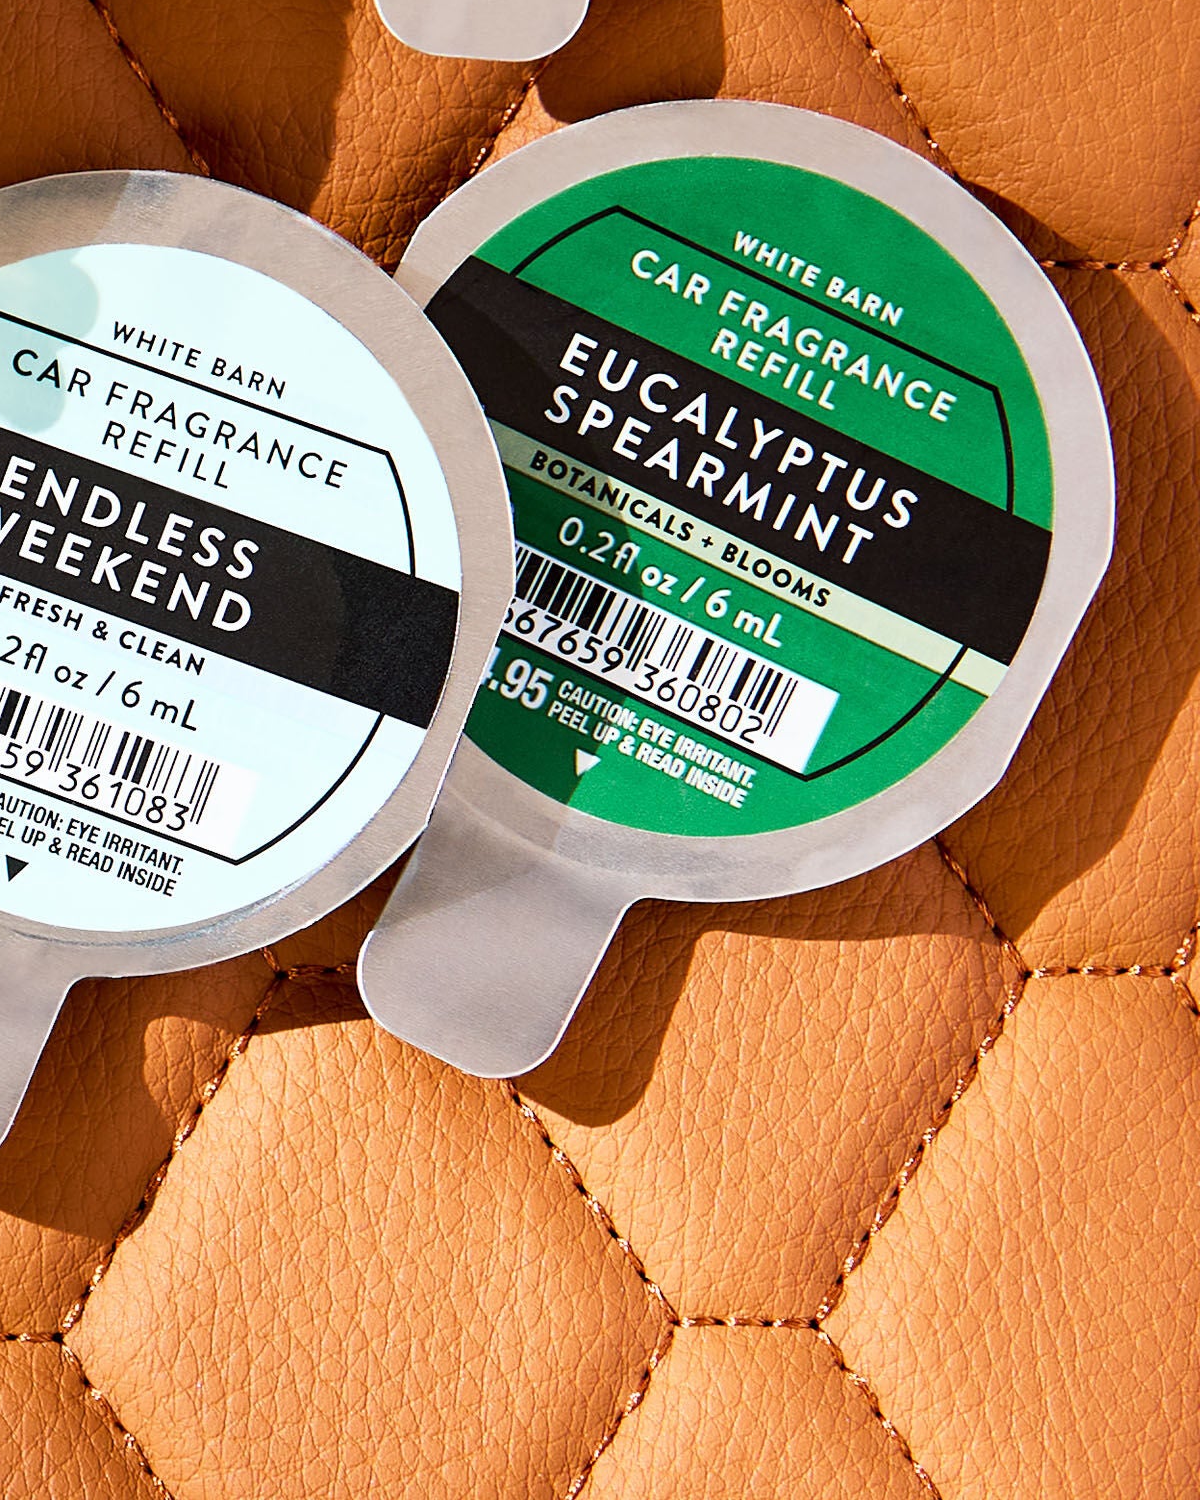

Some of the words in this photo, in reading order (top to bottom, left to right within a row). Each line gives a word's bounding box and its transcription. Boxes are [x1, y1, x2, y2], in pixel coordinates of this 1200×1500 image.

[734, 231, 821, 288] WHITE
[825, 276, 903, 327] BARN
[113, 321, 202, 369] WHITE
[210, 357, 286, 399] BARN
[631, 249, 710, 305] CAR
[718, 290, 957, 422] FRAGRANCE
[710, 328, 835, 411] REFILL
[12, 349, 91, 397] CAR
[105, 381, 348, 489] FRAGRANCE
[101, 420, 228, 489] REFILL
[559, 332, 918, 529] EUCALYPTUS
[544, 385, 874, 564] SPEARMINT
[0, 455, 260, 580] ENDLESS
[528, 449, 694, 541] BOTANICALS
[701, 535, 714, 548] +
[720, 542, 831, 607] BLOOMS
[92, 620, 109, 641] &
[119, 630, 206, 676] CLEAN
[641, 566, 678, 596] oz
[680, 576, 706, 603] /
[705, 589, 731, 618] 6
[732, 610, 782, 648] mL
[54, 665, 89, 691] oz
[95, 670, 116, 697] /
[121, 680, 143, 708] 6
[150, 699, 197, 732] mL
[558, 680, 640, 732] CAUTION:
[637, 718, 676, 749] EYE
[672, 735, 757, 789] IRRITANT.
[633, 662, 763, 744] 360802
[547, 700, 589, 734] PEEL
[592, 722, 621, 745] UP
[617, 735, 635, 756] &
[635, 742, 686, 779] READ
[684, 765, 748, 808] INSIDE
[58, 763, 190, 832] 361083
[21, 825, 46, 847] UP
[48, 836, 62, 856] &
[65, 842, 114, 873] READ
[116, 861, 177, 897] INSIDE
[65, 817, 101, 845] EYE
[102, 831, 184, 876] IRRITANT.
